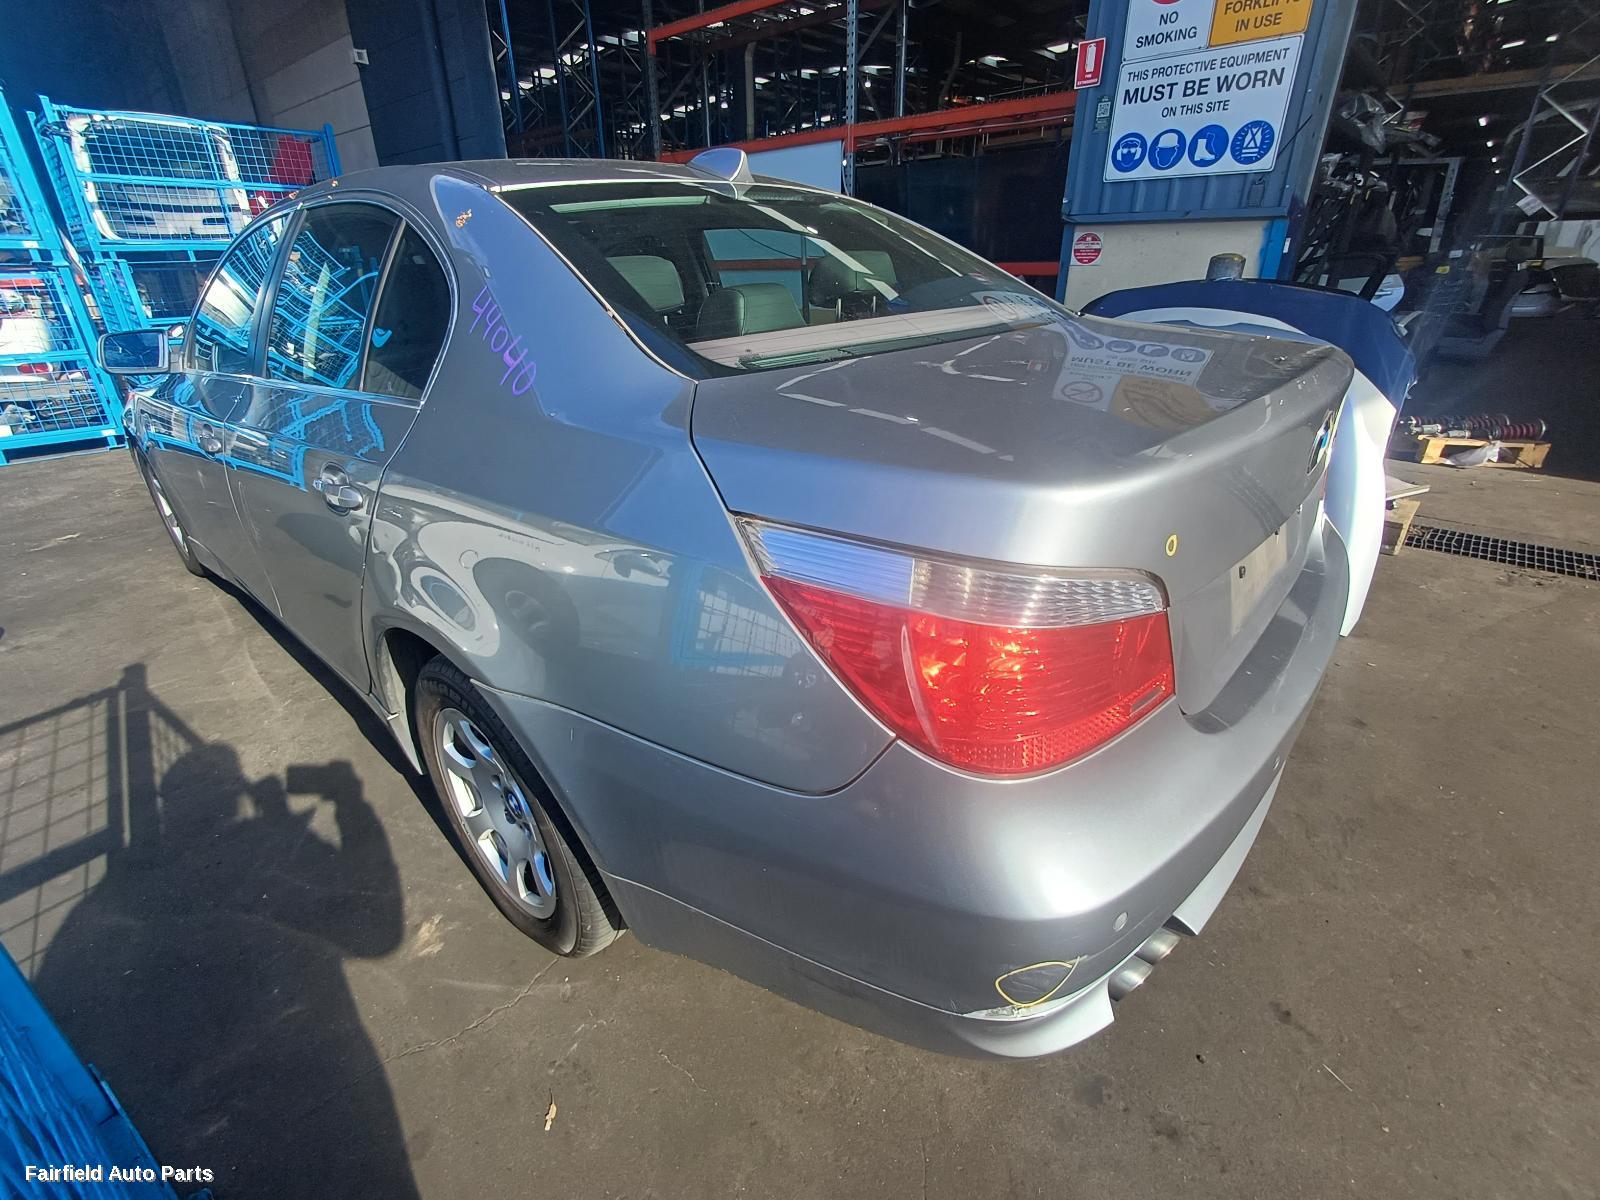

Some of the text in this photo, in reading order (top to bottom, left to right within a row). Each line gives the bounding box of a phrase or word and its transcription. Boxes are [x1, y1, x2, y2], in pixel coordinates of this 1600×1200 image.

[1224, 0, 1301, 15] FORKLI
[1158, 11, 1179, 26] NO
[1235, 12, 1283, 32] IN USE
[1135, 26, 1198, 48] SMOKING
[1127, 48, 1290, 83] THIS PROTECTIVE EQUIPMENT
[1122, 67, 1285, 105] MUST BE WORN
[1161, 100, 1230, 118] ON THIS SITE
[469, 286, 536, 395] 44040
